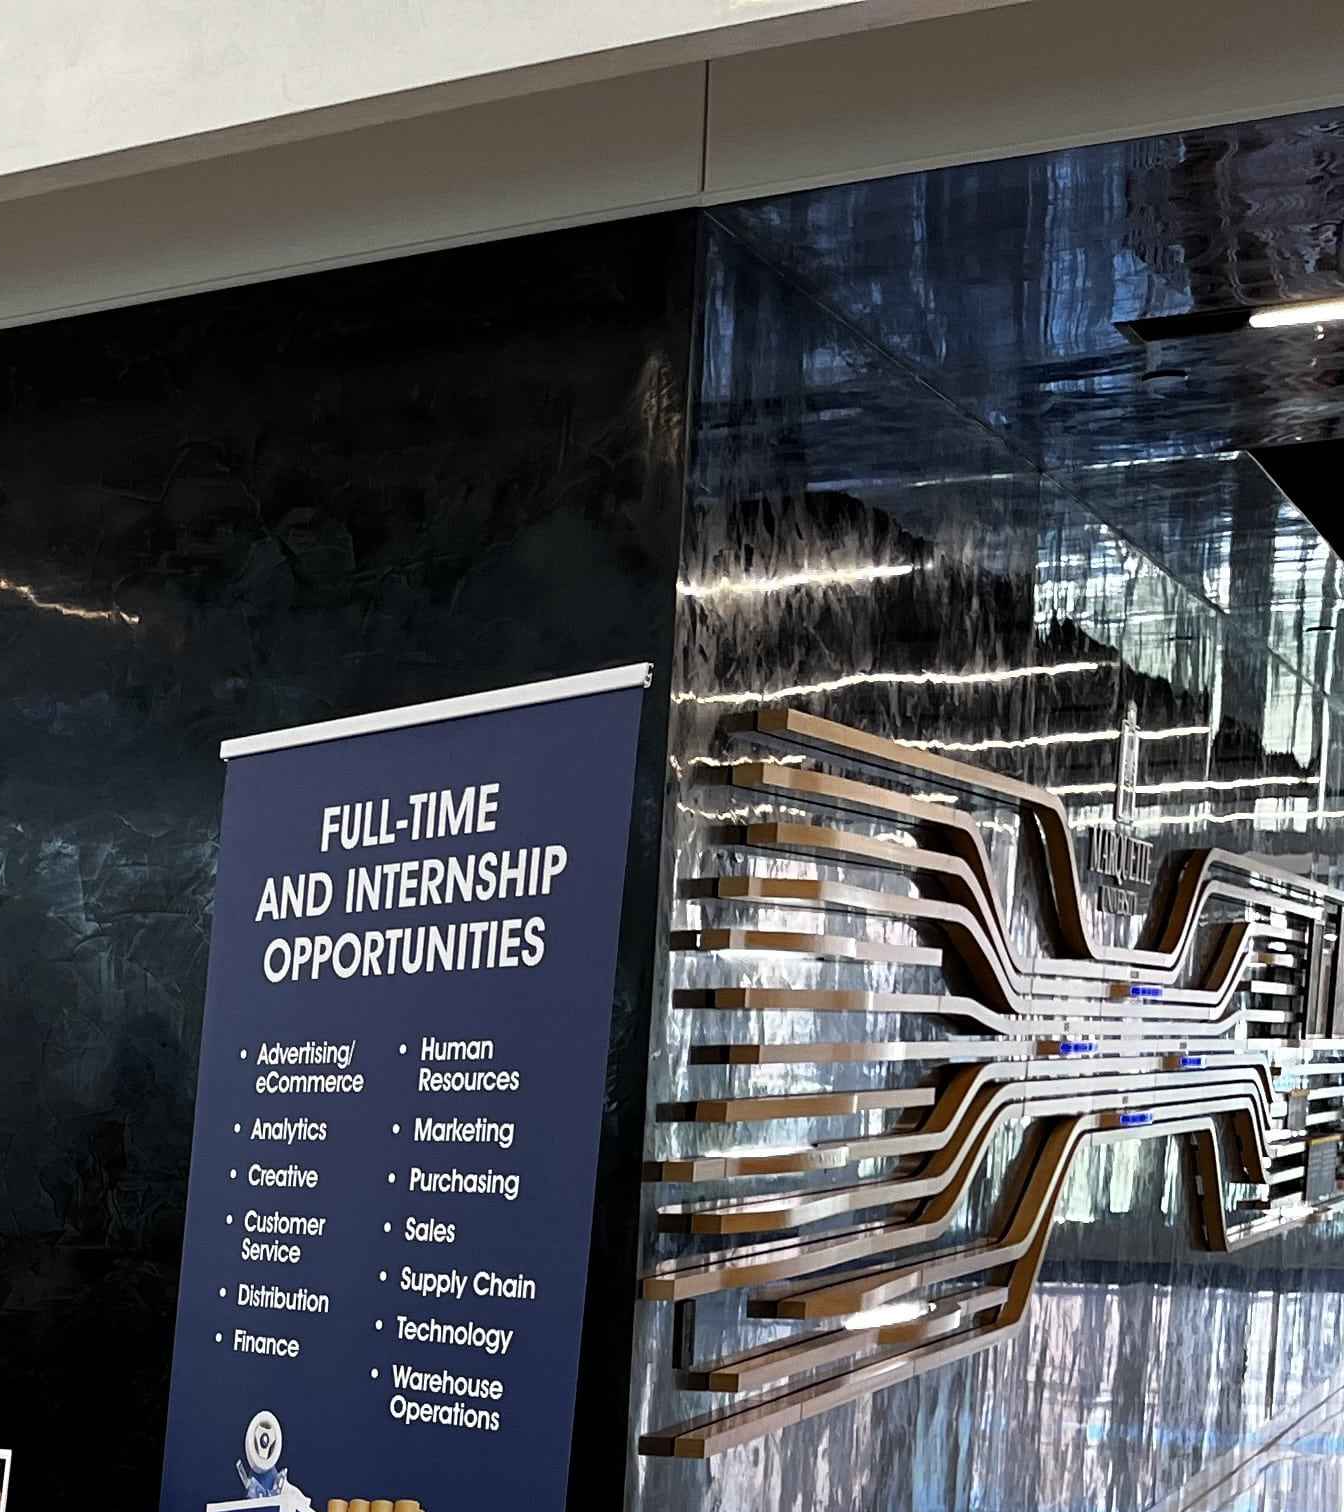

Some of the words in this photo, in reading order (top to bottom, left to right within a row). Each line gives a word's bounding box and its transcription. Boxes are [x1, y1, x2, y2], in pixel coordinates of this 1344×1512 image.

[321, 783, 499, 852] FULL-TIME
[255, 872, 333, 922] AND
[345, 845, 568, 913] INTERNSHIP
[263, 916, 546, 983] OPPORTUNITIES
[256, 1039, 356, 1069] Advertising/
[421, 1036, 494, 1061] Human
[255, 1071, 364, 1094] eCommerce
[418, 1067, 520, 1092] Resources
[250, 1117, 328, 1145] Analytics
[414, 1117, 515, 1149] Marketing
[248, 1163, 319, 1188] Creative
[409, 1167, 520, 1201] Purchasing
[244, 1210, 326, 1236] Customer
[404, 1216, 456, 1243] Sales
[241, 1237, 301, 1264] Service
[400, 1266, 468, 1299] Supply
[473, 1270, 536, 1299] Chain
[238, 1283, 329, 1313] Distribution
[233, 1329, 300, 1358] Finance
[397, 1315, 514, 1355] Technology
[392, 1364, 504, 1400] Warehouse
[390, 1394, 500, 1431] Operations
